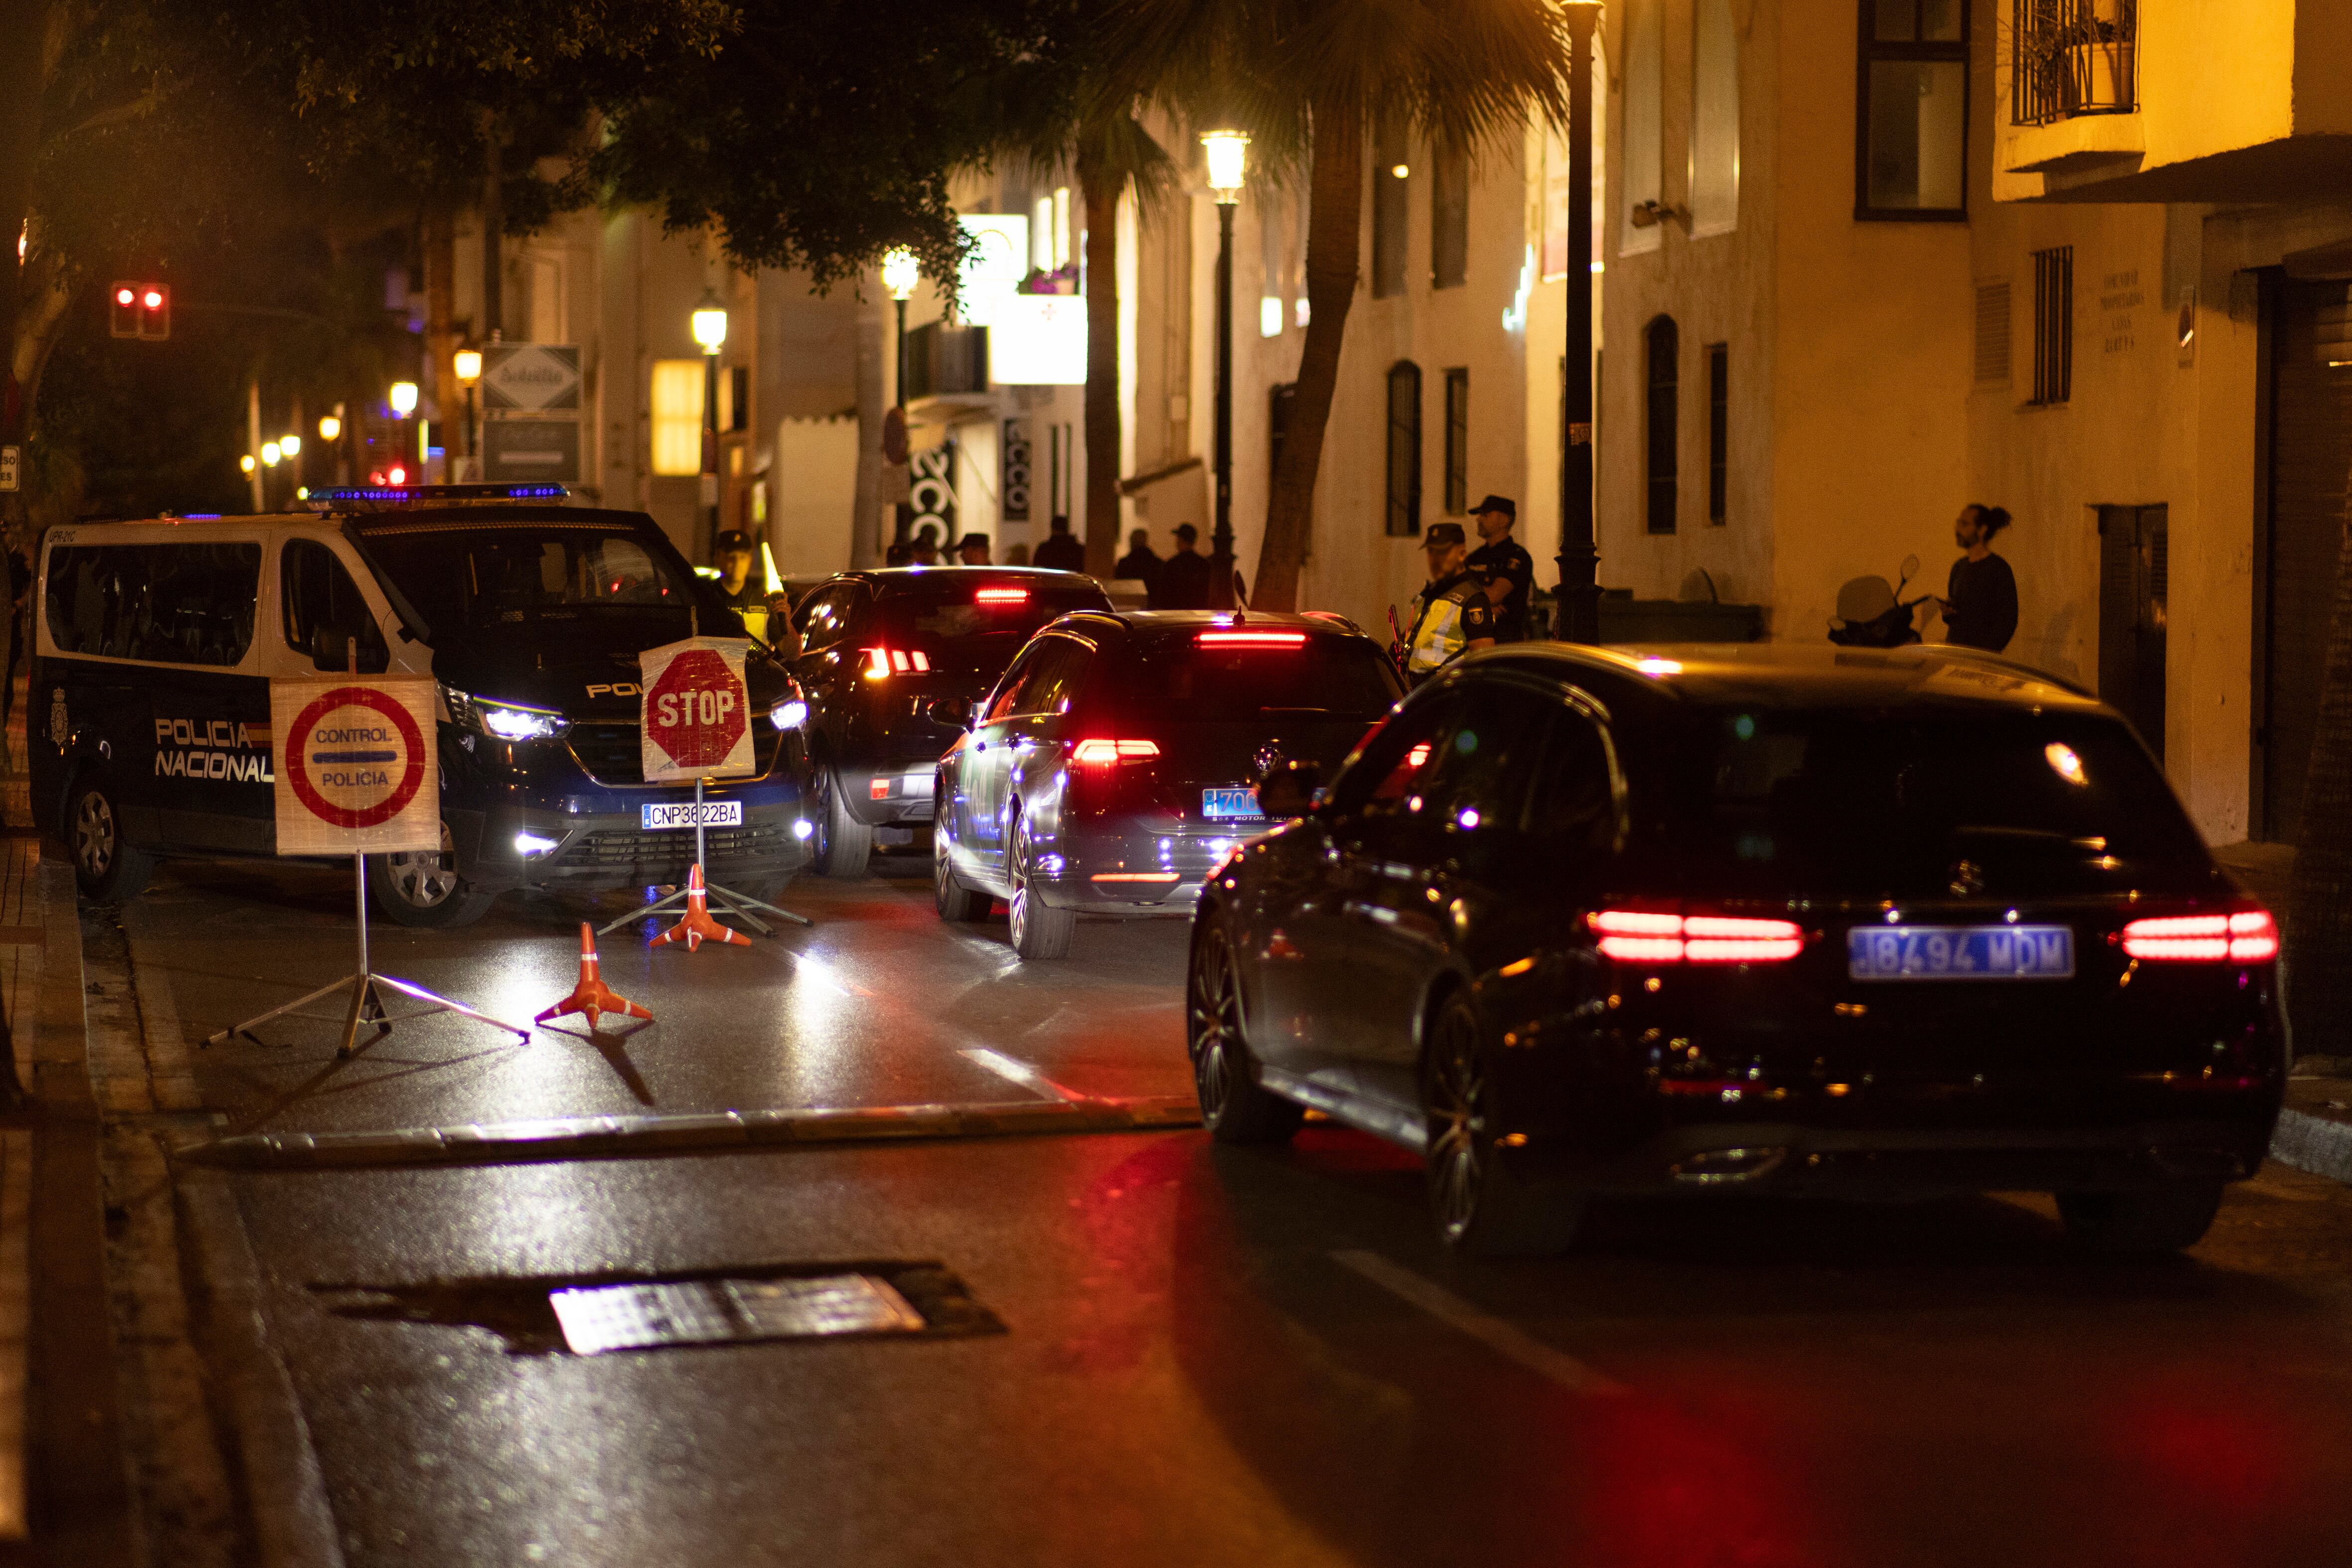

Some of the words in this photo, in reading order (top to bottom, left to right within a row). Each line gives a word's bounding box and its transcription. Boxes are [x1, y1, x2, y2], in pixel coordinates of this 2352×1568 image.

[911, 449, 949, 566] ecc
[658, 690, 734, 727] STOP
[316, 728, 393, 744] CONTROL
[155, 750, 275, 783] NACIONAL
[322, 771, 389, 786] POLICIA
[1220, 792, 1259, 812] 700
